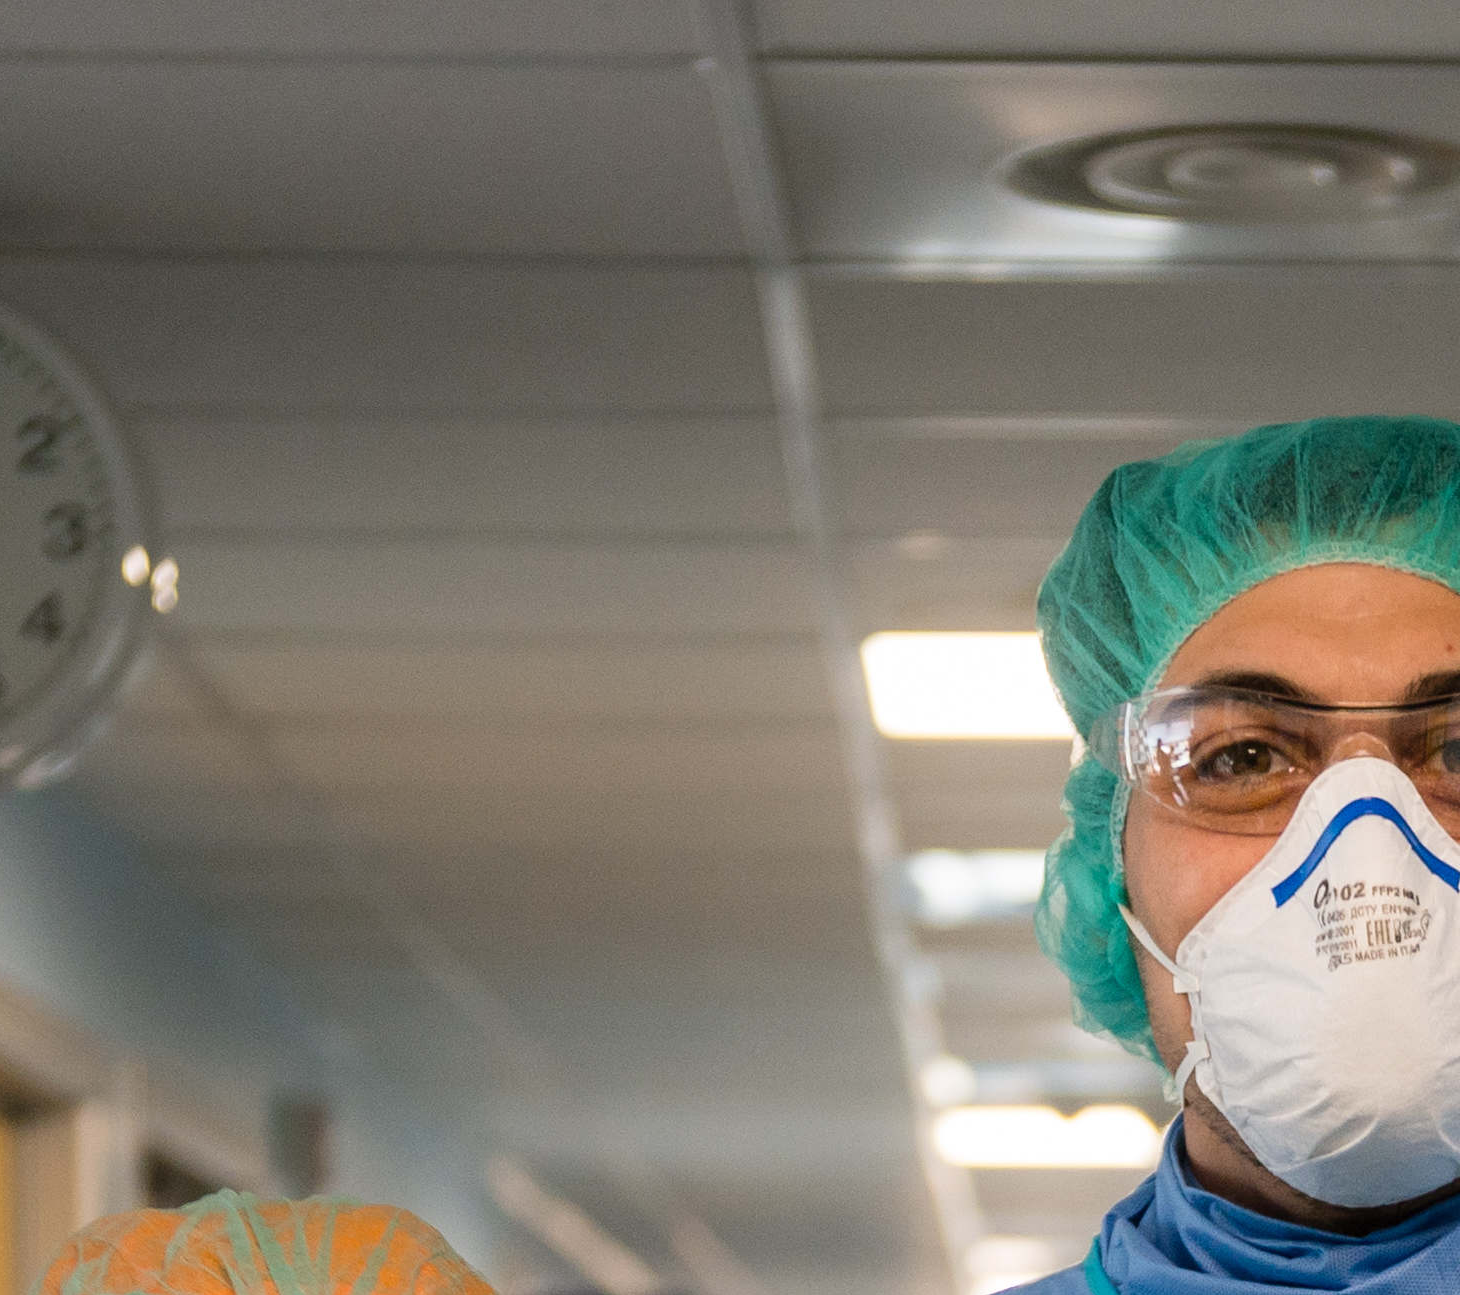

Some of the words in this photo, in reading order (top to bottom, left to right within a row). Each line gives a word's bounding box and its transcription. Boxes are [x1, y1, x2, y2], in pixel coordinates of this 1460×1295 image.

[15, 415, 61, 473] 2
[42, 503, 89, 559] 3
[21, 592, 64, 642] 4
[1355, 949, 1385, 961] MADE
